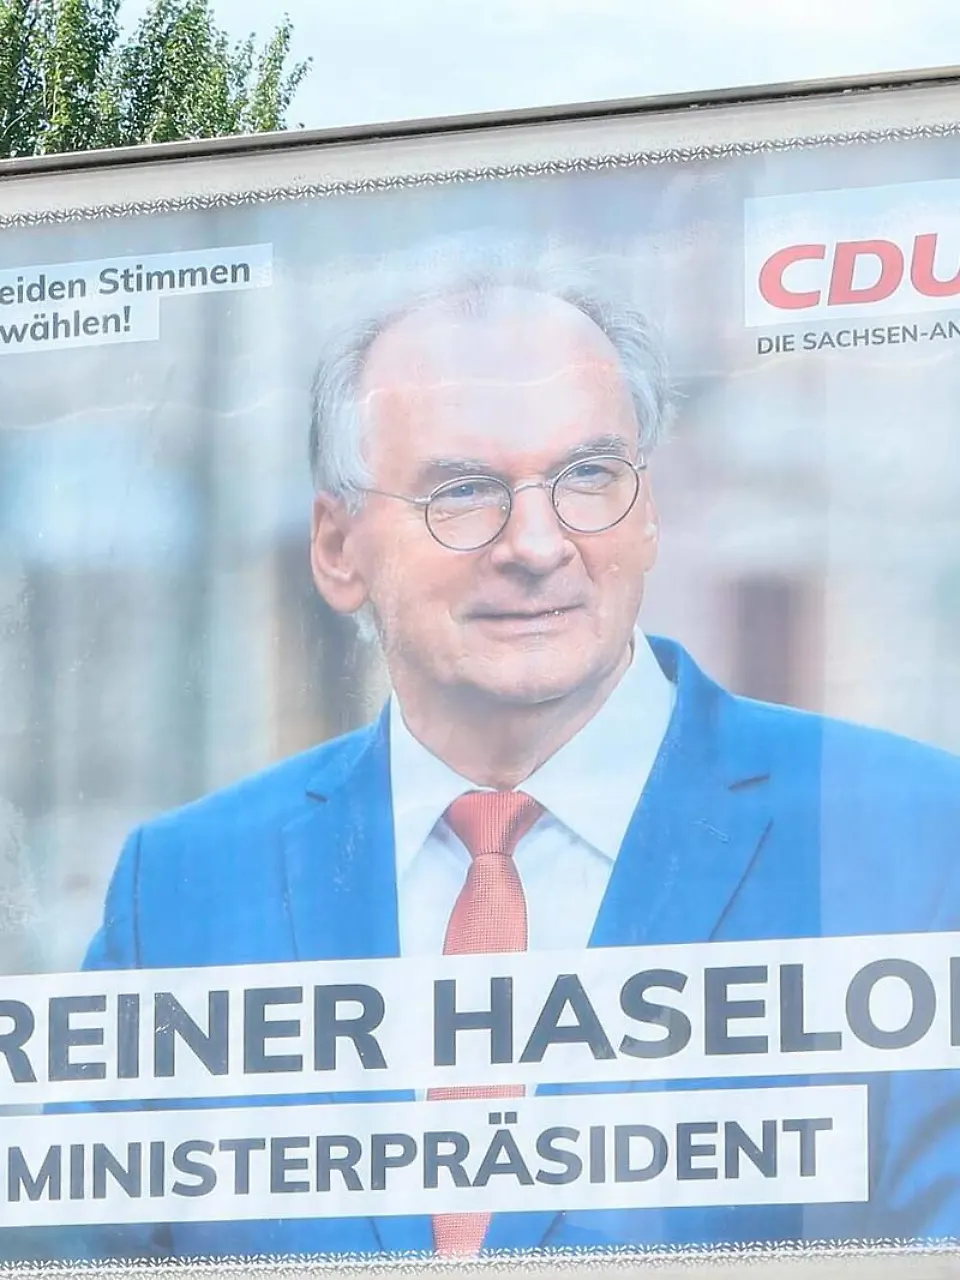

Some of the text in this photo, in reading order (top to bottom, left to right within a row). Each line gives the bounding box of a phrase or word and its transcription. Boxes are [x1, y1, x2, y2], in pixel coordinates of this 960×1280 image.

[98, 260, 251, 295] Stimmen
[758, 233, 960, 310] CDU
[0, 305, 132, 344] wählen!
[757, 334, 795, 355] DIE
[433, 956, 960, 1066] HASELO
[7, 1111, 833, 1202] MINISTERPRÄSIDENT
